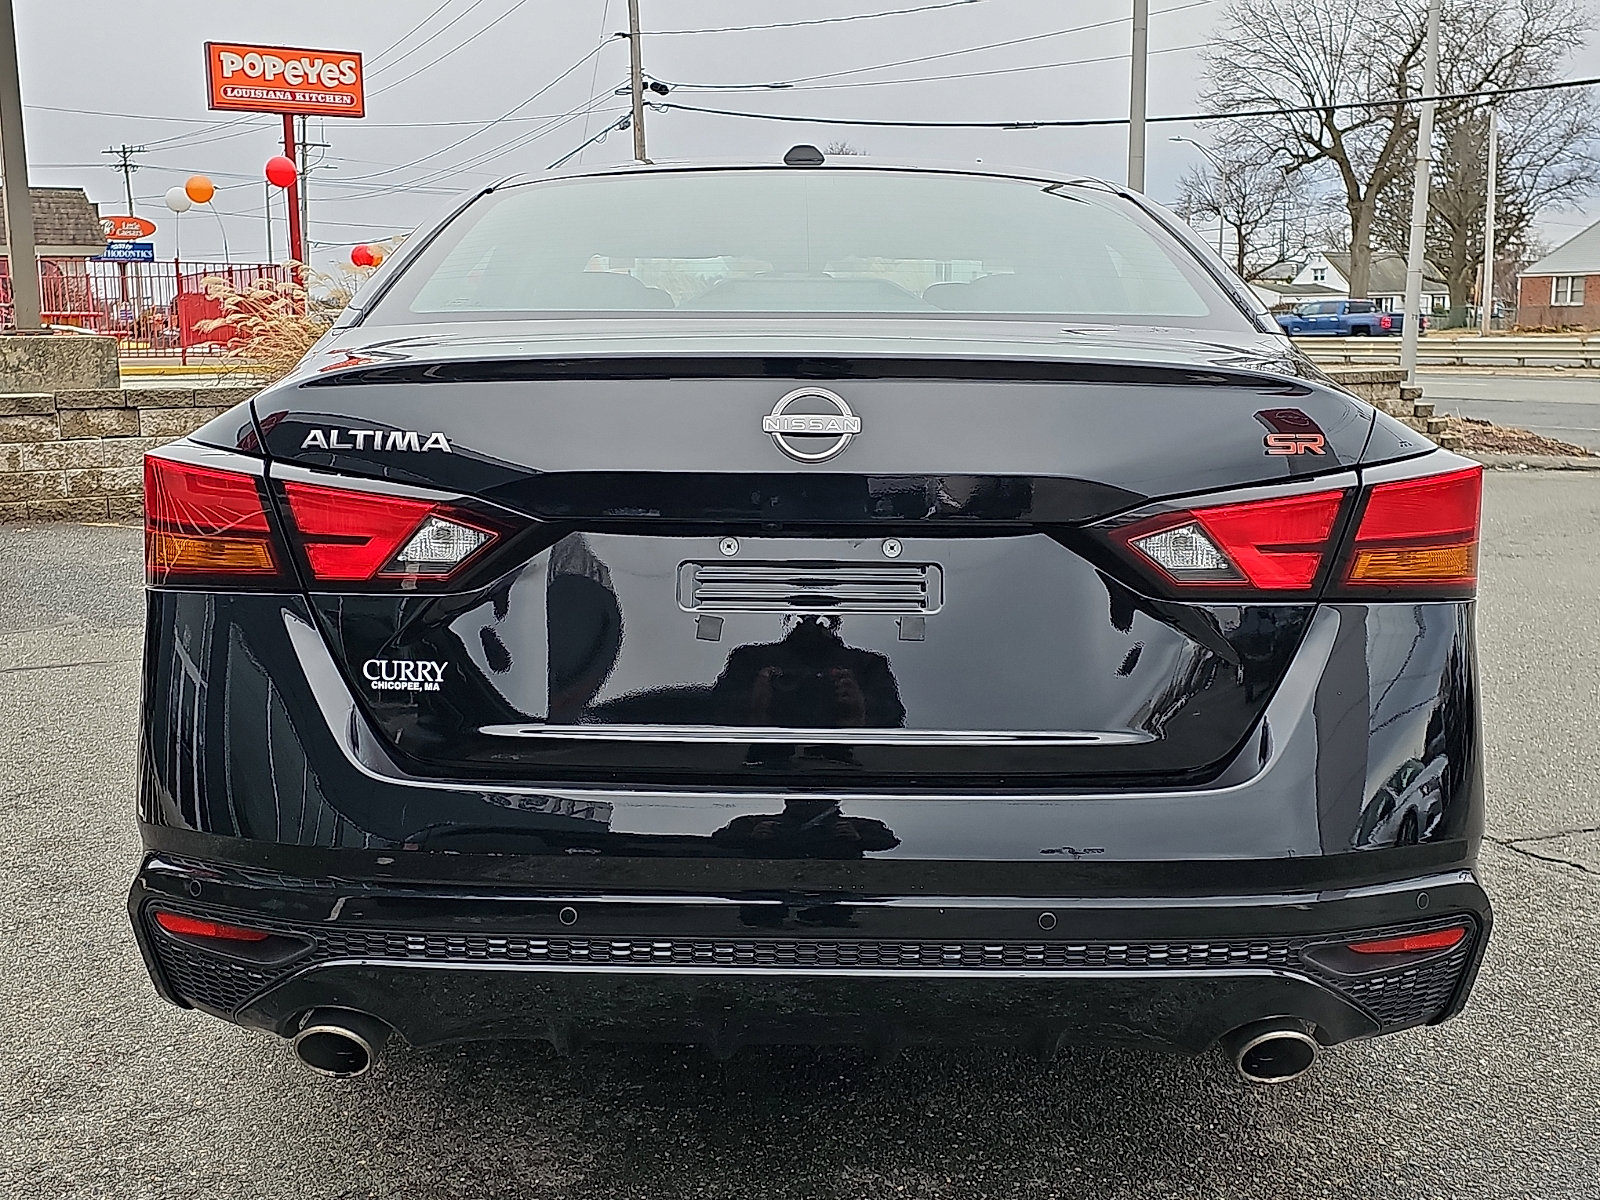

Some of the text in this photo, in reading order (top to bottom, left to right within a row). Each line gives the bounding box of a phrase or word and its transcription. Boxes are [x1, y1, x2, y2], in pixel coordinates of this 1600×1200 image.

[226, 87, 352, 105] LOUISIANA KITCHEN
[765, 418, 858, 431] NISSAN
[300, 429, 453, 453] ALTIMA
[1265, 433, 1327, 455] SR
[362, 659, 449, 682] CURRY
[371, 681, 441, 692] CHICOPEE, MA
